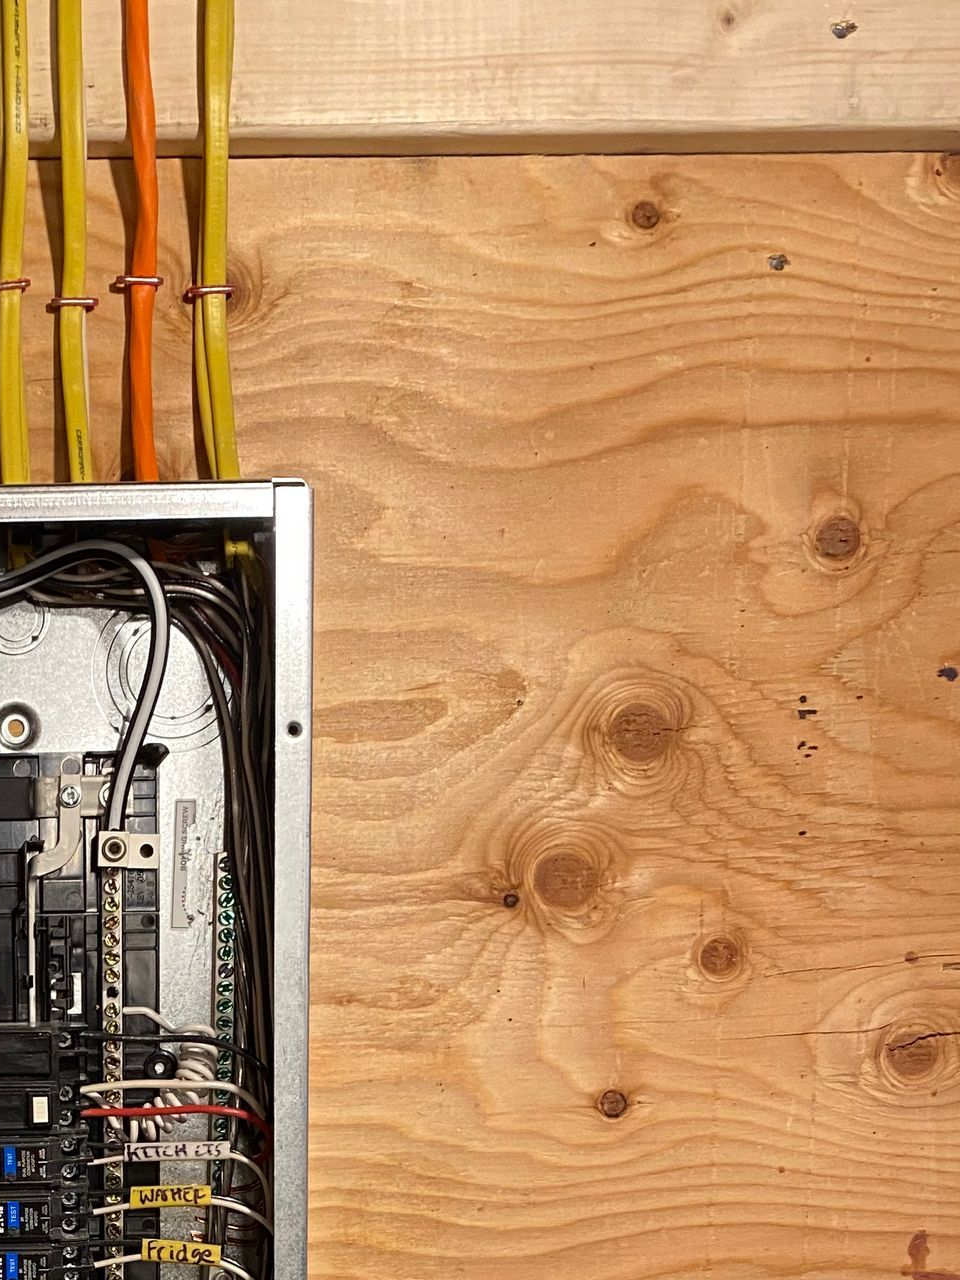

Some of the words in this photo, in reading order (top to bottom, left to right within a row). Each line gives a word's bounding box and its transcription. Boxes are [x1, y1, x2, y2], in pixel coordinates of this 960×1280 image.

[127, 1143, 187, 1161] KITCH
[137, 1186, 207, 1205] WASHER
[147, 1240, 215, 1265] Fridge
